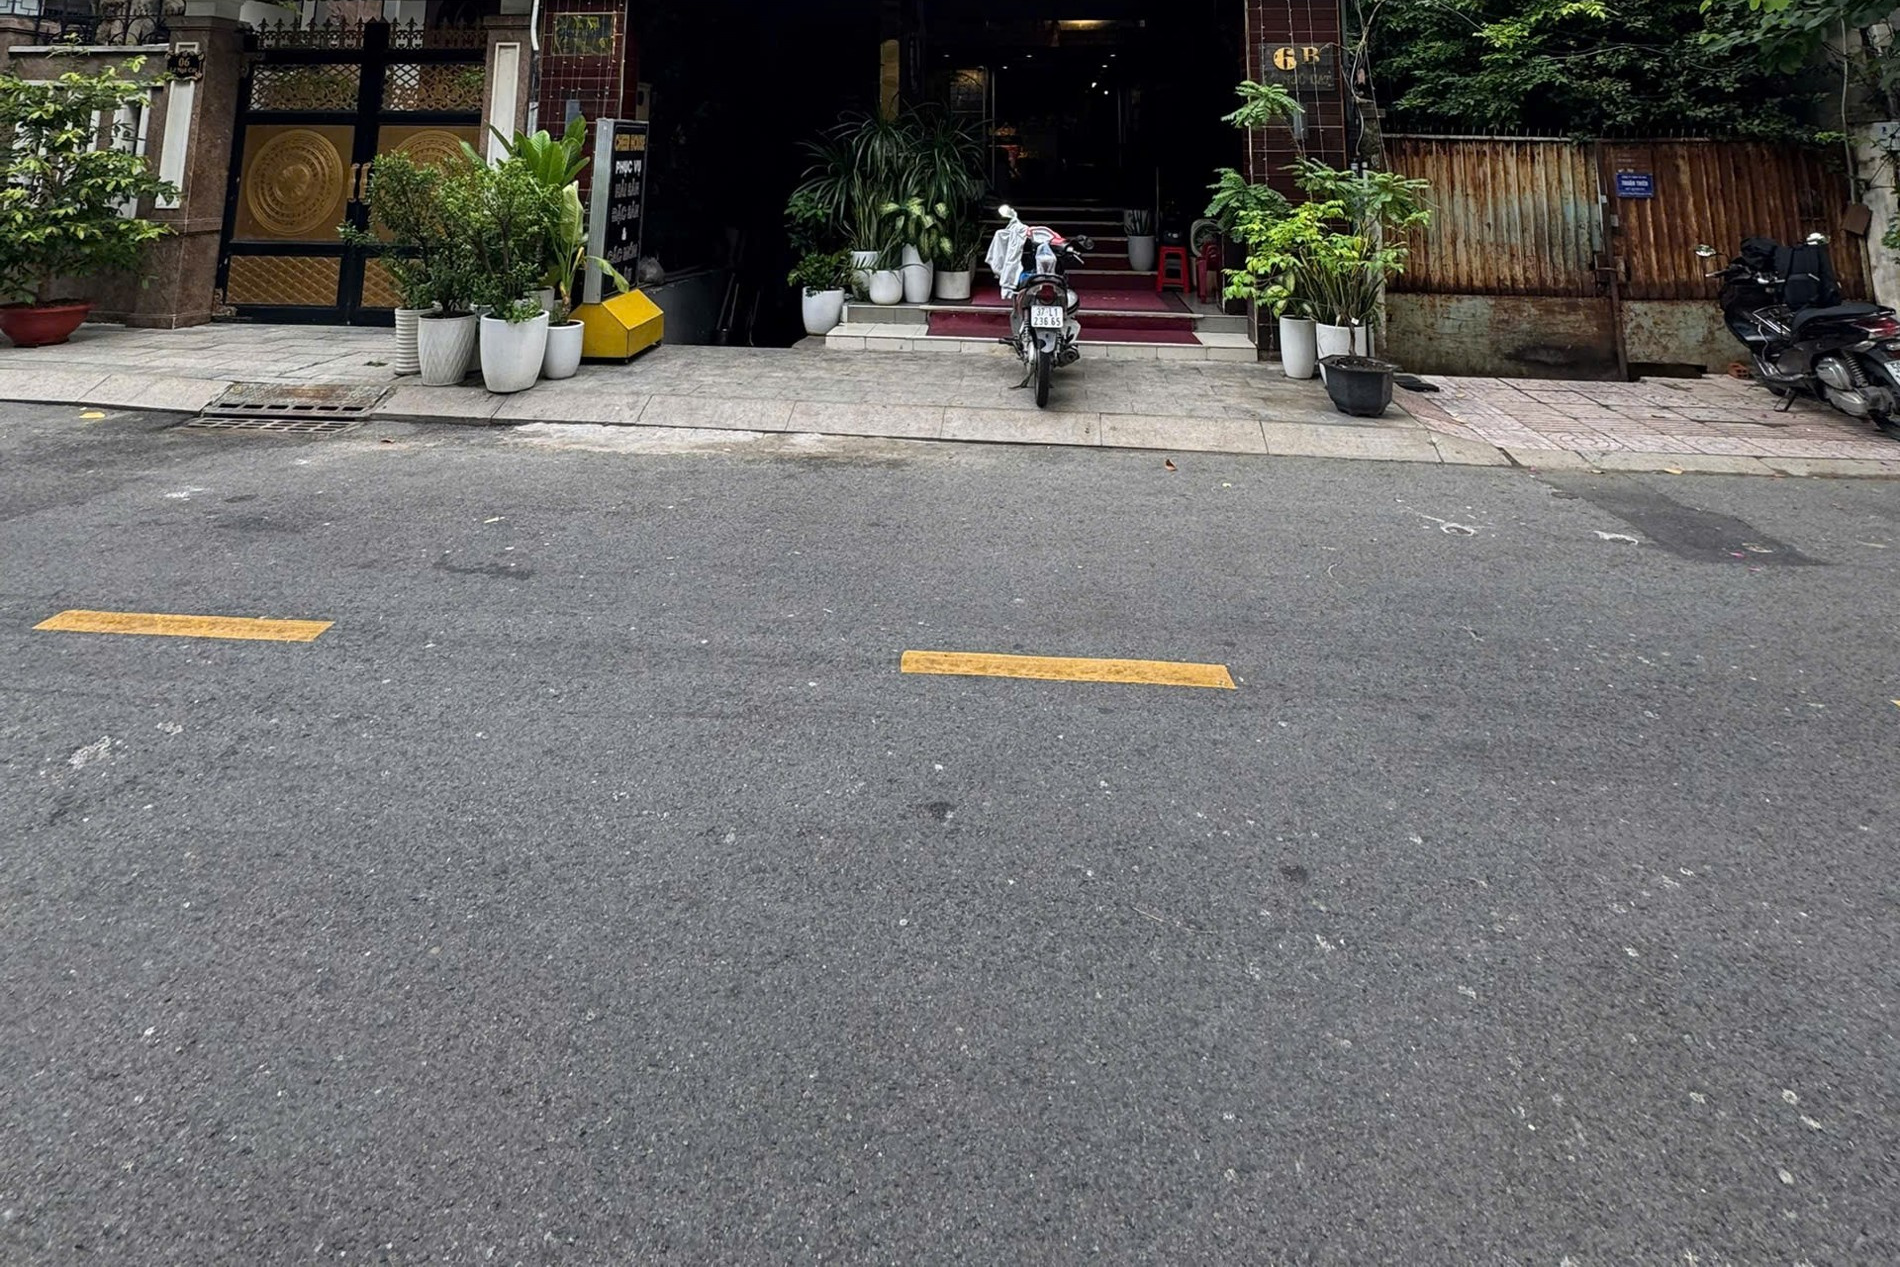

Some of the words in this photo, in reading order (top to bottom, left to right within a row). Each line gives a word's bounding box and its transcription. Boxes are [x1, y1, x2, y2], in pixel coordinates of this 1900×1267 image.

[178, 57, 190, 67] 06
[615, 160, 633, 177] PHỤC
[633, 159, 642, 177] VỤ
